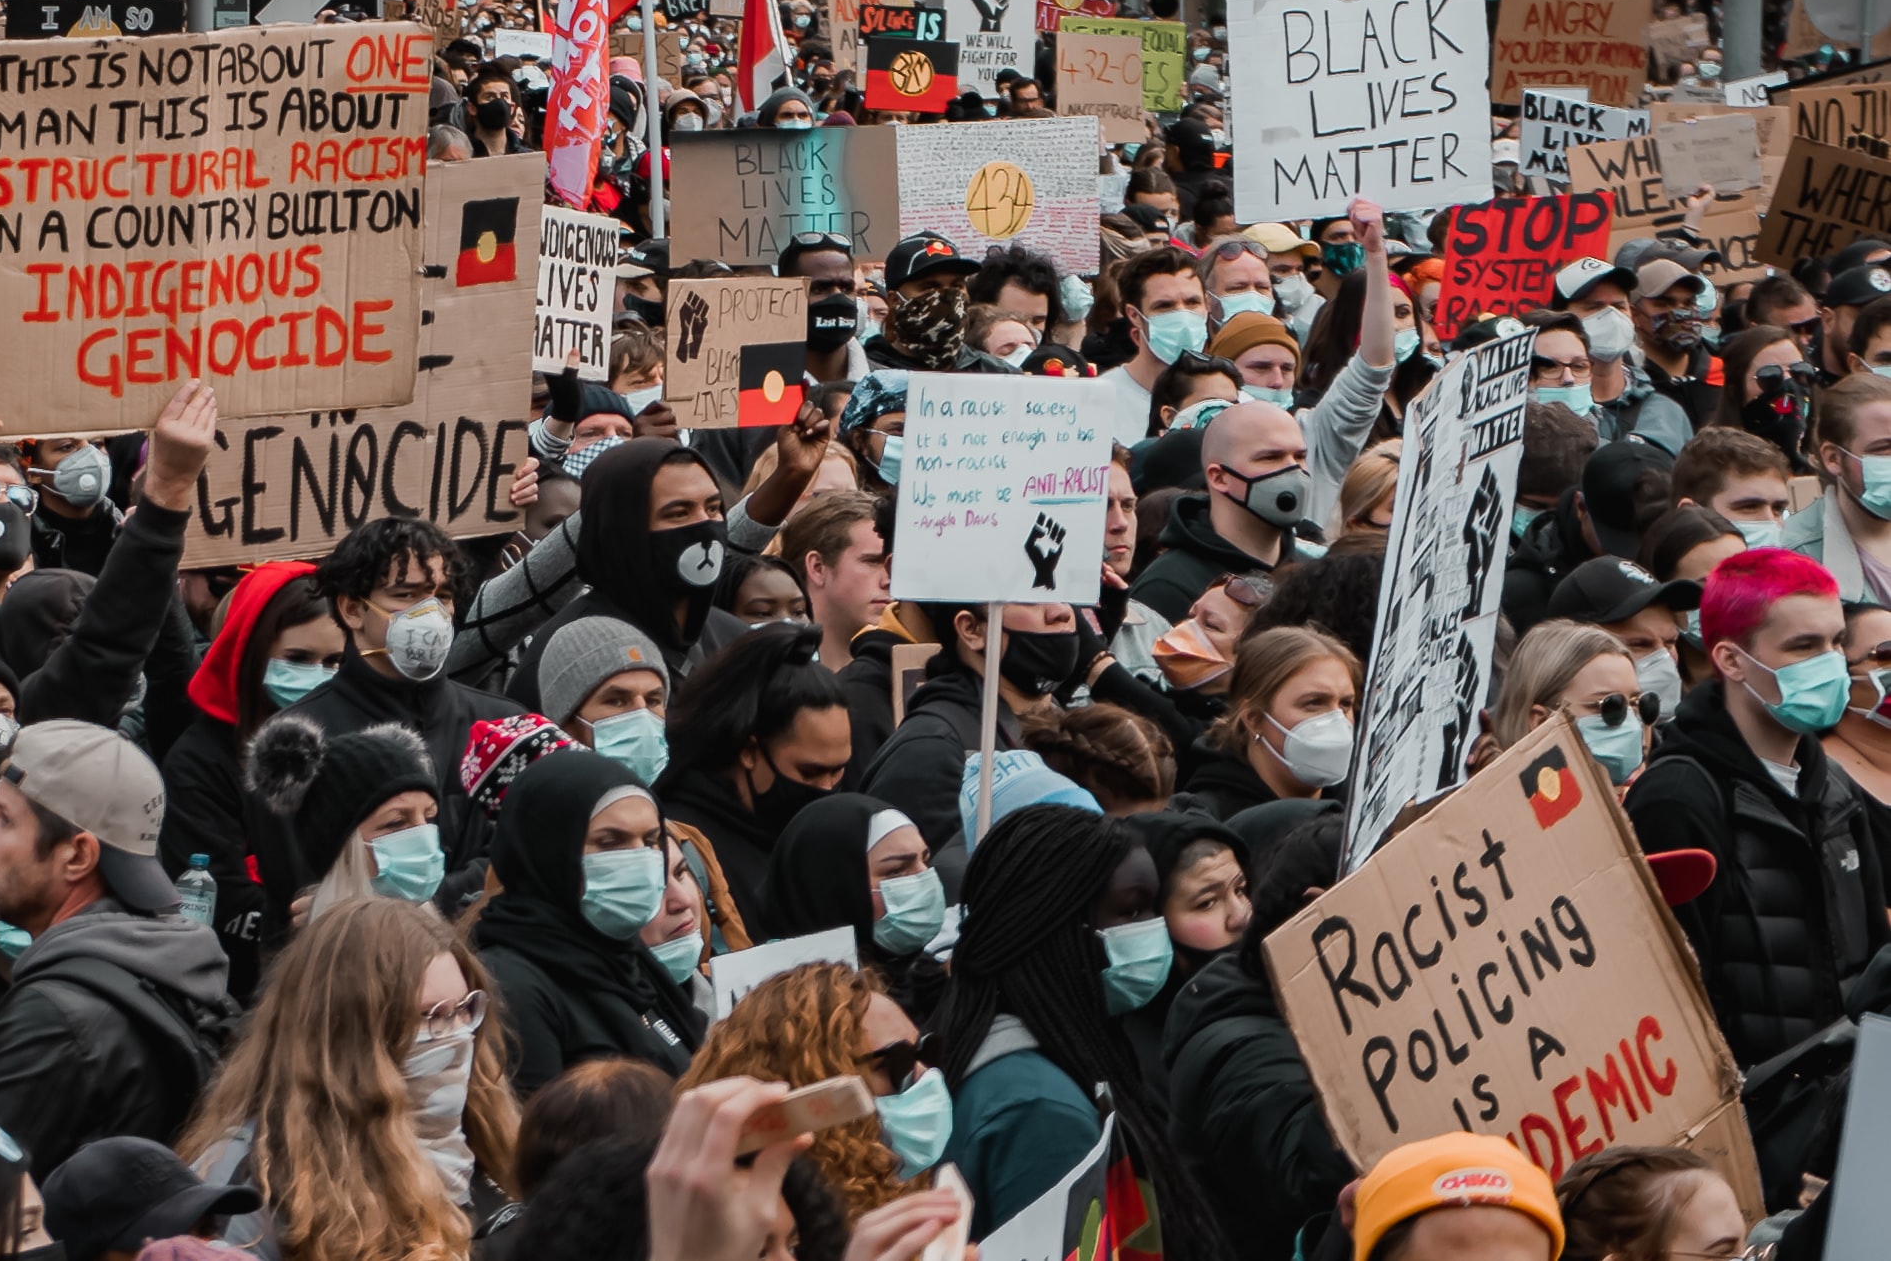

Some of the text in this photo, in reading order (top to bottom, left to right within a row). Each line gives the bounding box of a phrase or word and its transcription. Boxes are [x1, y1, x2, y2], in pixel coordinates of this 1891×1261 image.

[40, 4, 156, 32] I AM SO
[860, 4, 942, 42] SILENCE IS
[1522, 0, 1615, 39] ANGRY
[84, 47, 128, 89] IS
[138, 42, 222, 88] NOT
[217, 37, 336, 87] ABOUT
[344, 34, 435, 85] ONE
[959, 50, 1018, 67] FIGHT FOR
[966, 34, 1013, 50] WE WILL
[1059, 47, 1142, 86] 432-0
[107, 94, 210, 145] THIS
[224, 89, 270, 133] IS
[276, 86, 410, 137] ABOUT
[1309, 70, 1458, 139] LIVES
[1523, 92, 1606, 133] BLACK
[289, 135, 430, 185] RACISM
[734, 141, 829, 176] BLACK
[1273, 132, 1469, 206] MATTER
[741, 172, 837, 210] LIVES
[37, 209, 70, 254] A
[85, 193, 258, 250] COUNTRY
[1452, 192, 1609, 258] STOP
[22, 244, 324, 325] INDIGENOUS
[718, 286, 805, 330] PROTECT
[76, 298, 395, 399] GENOCIDE
[692, 385, 739, 423] LIVES
[919, 386, 1077, 425] In a racist society
[937, 432, 949, 448] is
[962, 431, 989, 446] not
[1001, 427, 1047, 451] enough
[1056, 430, 1071, 443] to
[1076, 427, 1096, 443] be
[915, 454, 1009, 472] non-racist
[912, 465, 1111, 508] We must be ANTI-RACIST
[1527, 1025, 1566, 1082] A
